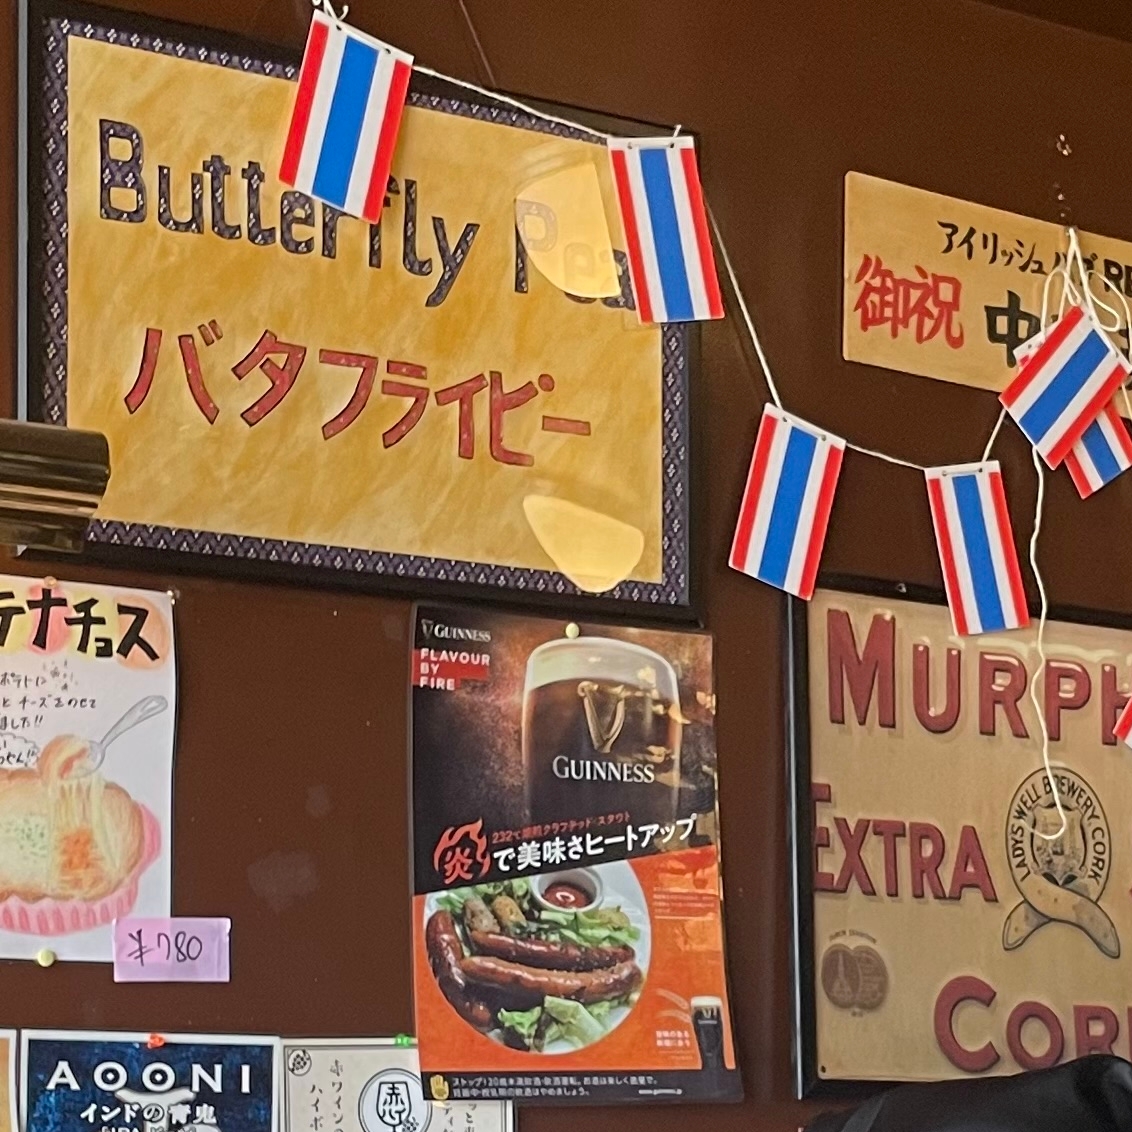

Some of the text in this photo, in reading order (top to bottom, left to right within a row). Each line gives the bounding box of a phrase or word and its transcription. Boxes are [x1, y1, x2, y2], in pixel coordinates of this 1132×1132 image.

[853, 253, 965, 349] 御祝
[124, 319, 591, 467] バタフライピー
[434, 623, 492, 643] GUINNESS
[420, 647, 491, 667] FLAVOUR
[420, 661, 440, 675] BY
[419, 675, 456, 691] FIRE
[552, 755, 656, 784] GUINNESS
[811, 782, 999, 903] EXTRA
[1012, 783, 1042, 821] WELL
[1087, 826, 1107, 886] CORK
[128, 929, 203, 967] ¥780
[46, 1060, 251, 1094] AOONI
[79, 1103, 218, 1125] インドの青鬼
